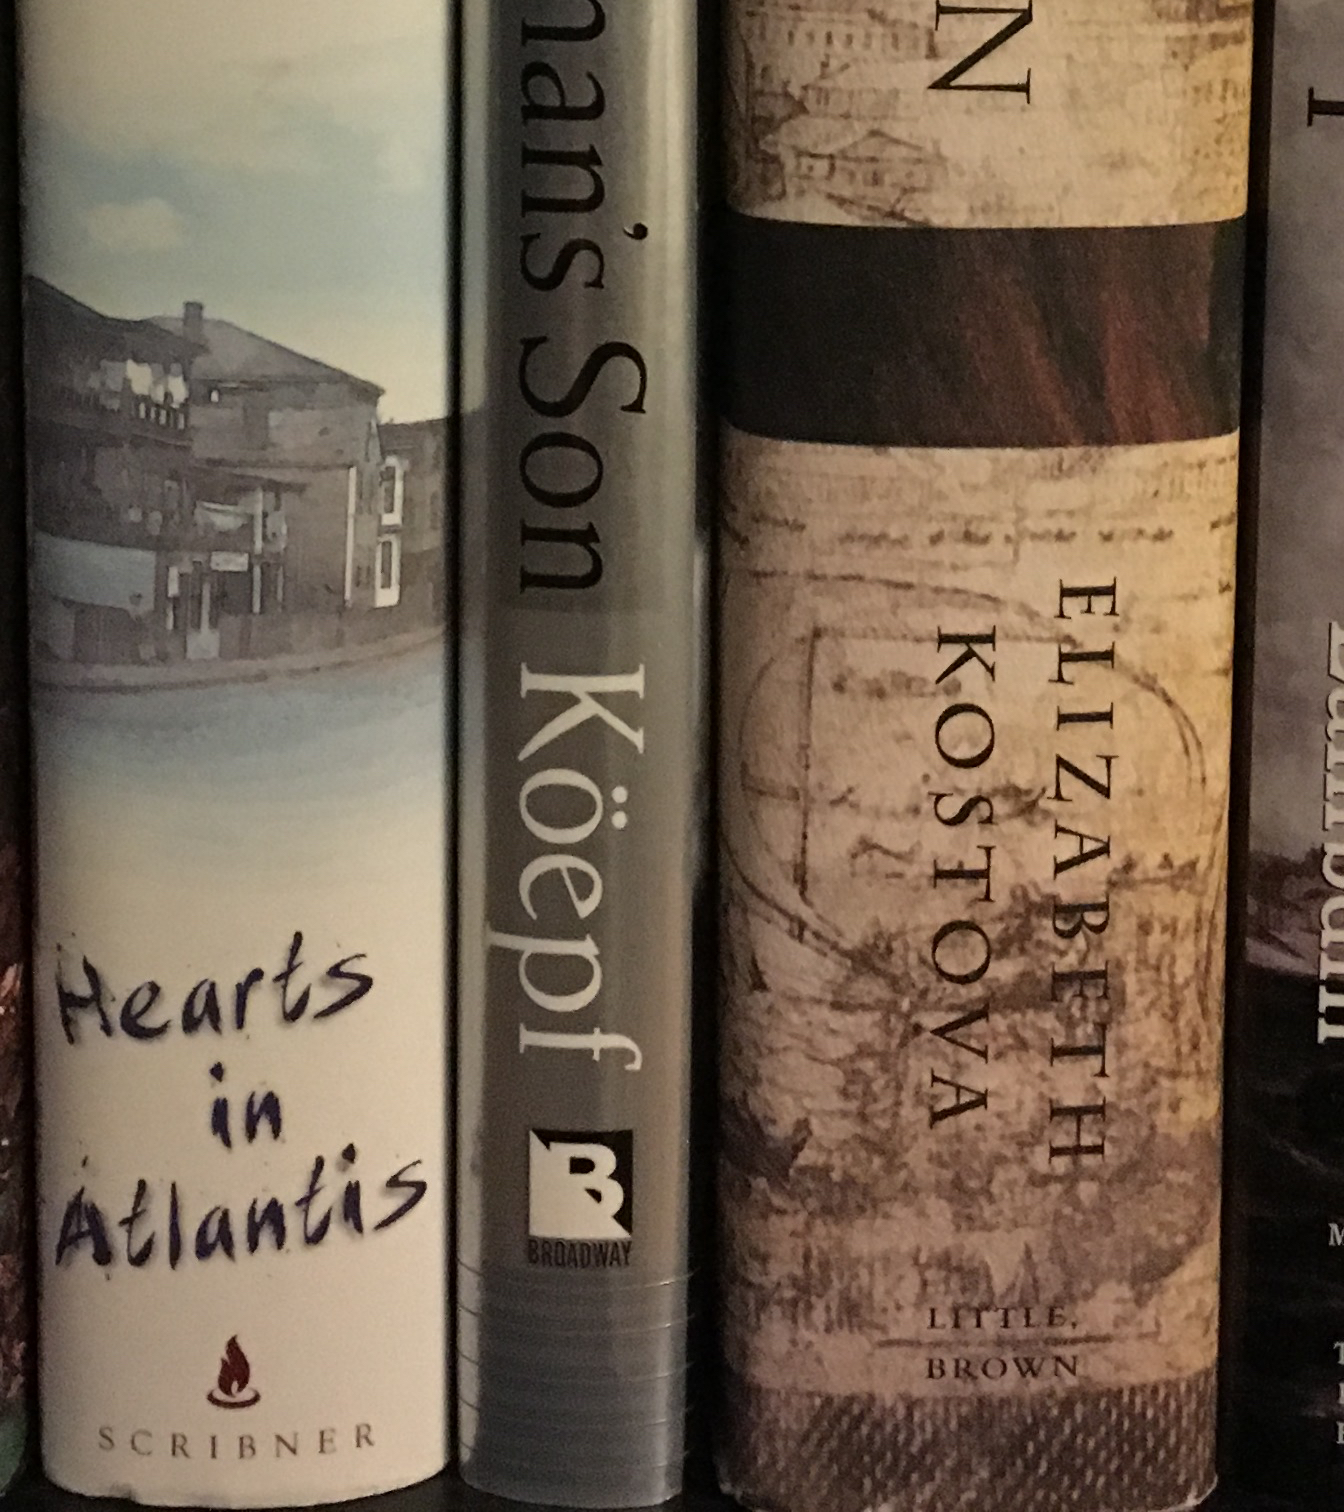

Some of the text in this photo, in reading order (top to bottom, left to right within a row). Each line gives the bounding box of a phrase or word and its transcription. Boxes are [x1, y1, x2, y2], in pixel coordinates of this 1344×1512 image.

[518, 335, 649, 595] Son
[485, 661, 646, 1072] Köepf
[927, 624, 996, 1129] KOSTOVA
[1047, 575, 1120, 1165] ELIZABETH
[56, 931, 374, 1045] Hearts
[209, 1061, 284, 1149] in
[56, 1142, 428, 1269] Atlantis
[527, 1239, 633, 1270] BROADWAY
[926, 1354, 1080, 1381] BROWN
[98, 1422, 377, 1461] SCRIBNER
